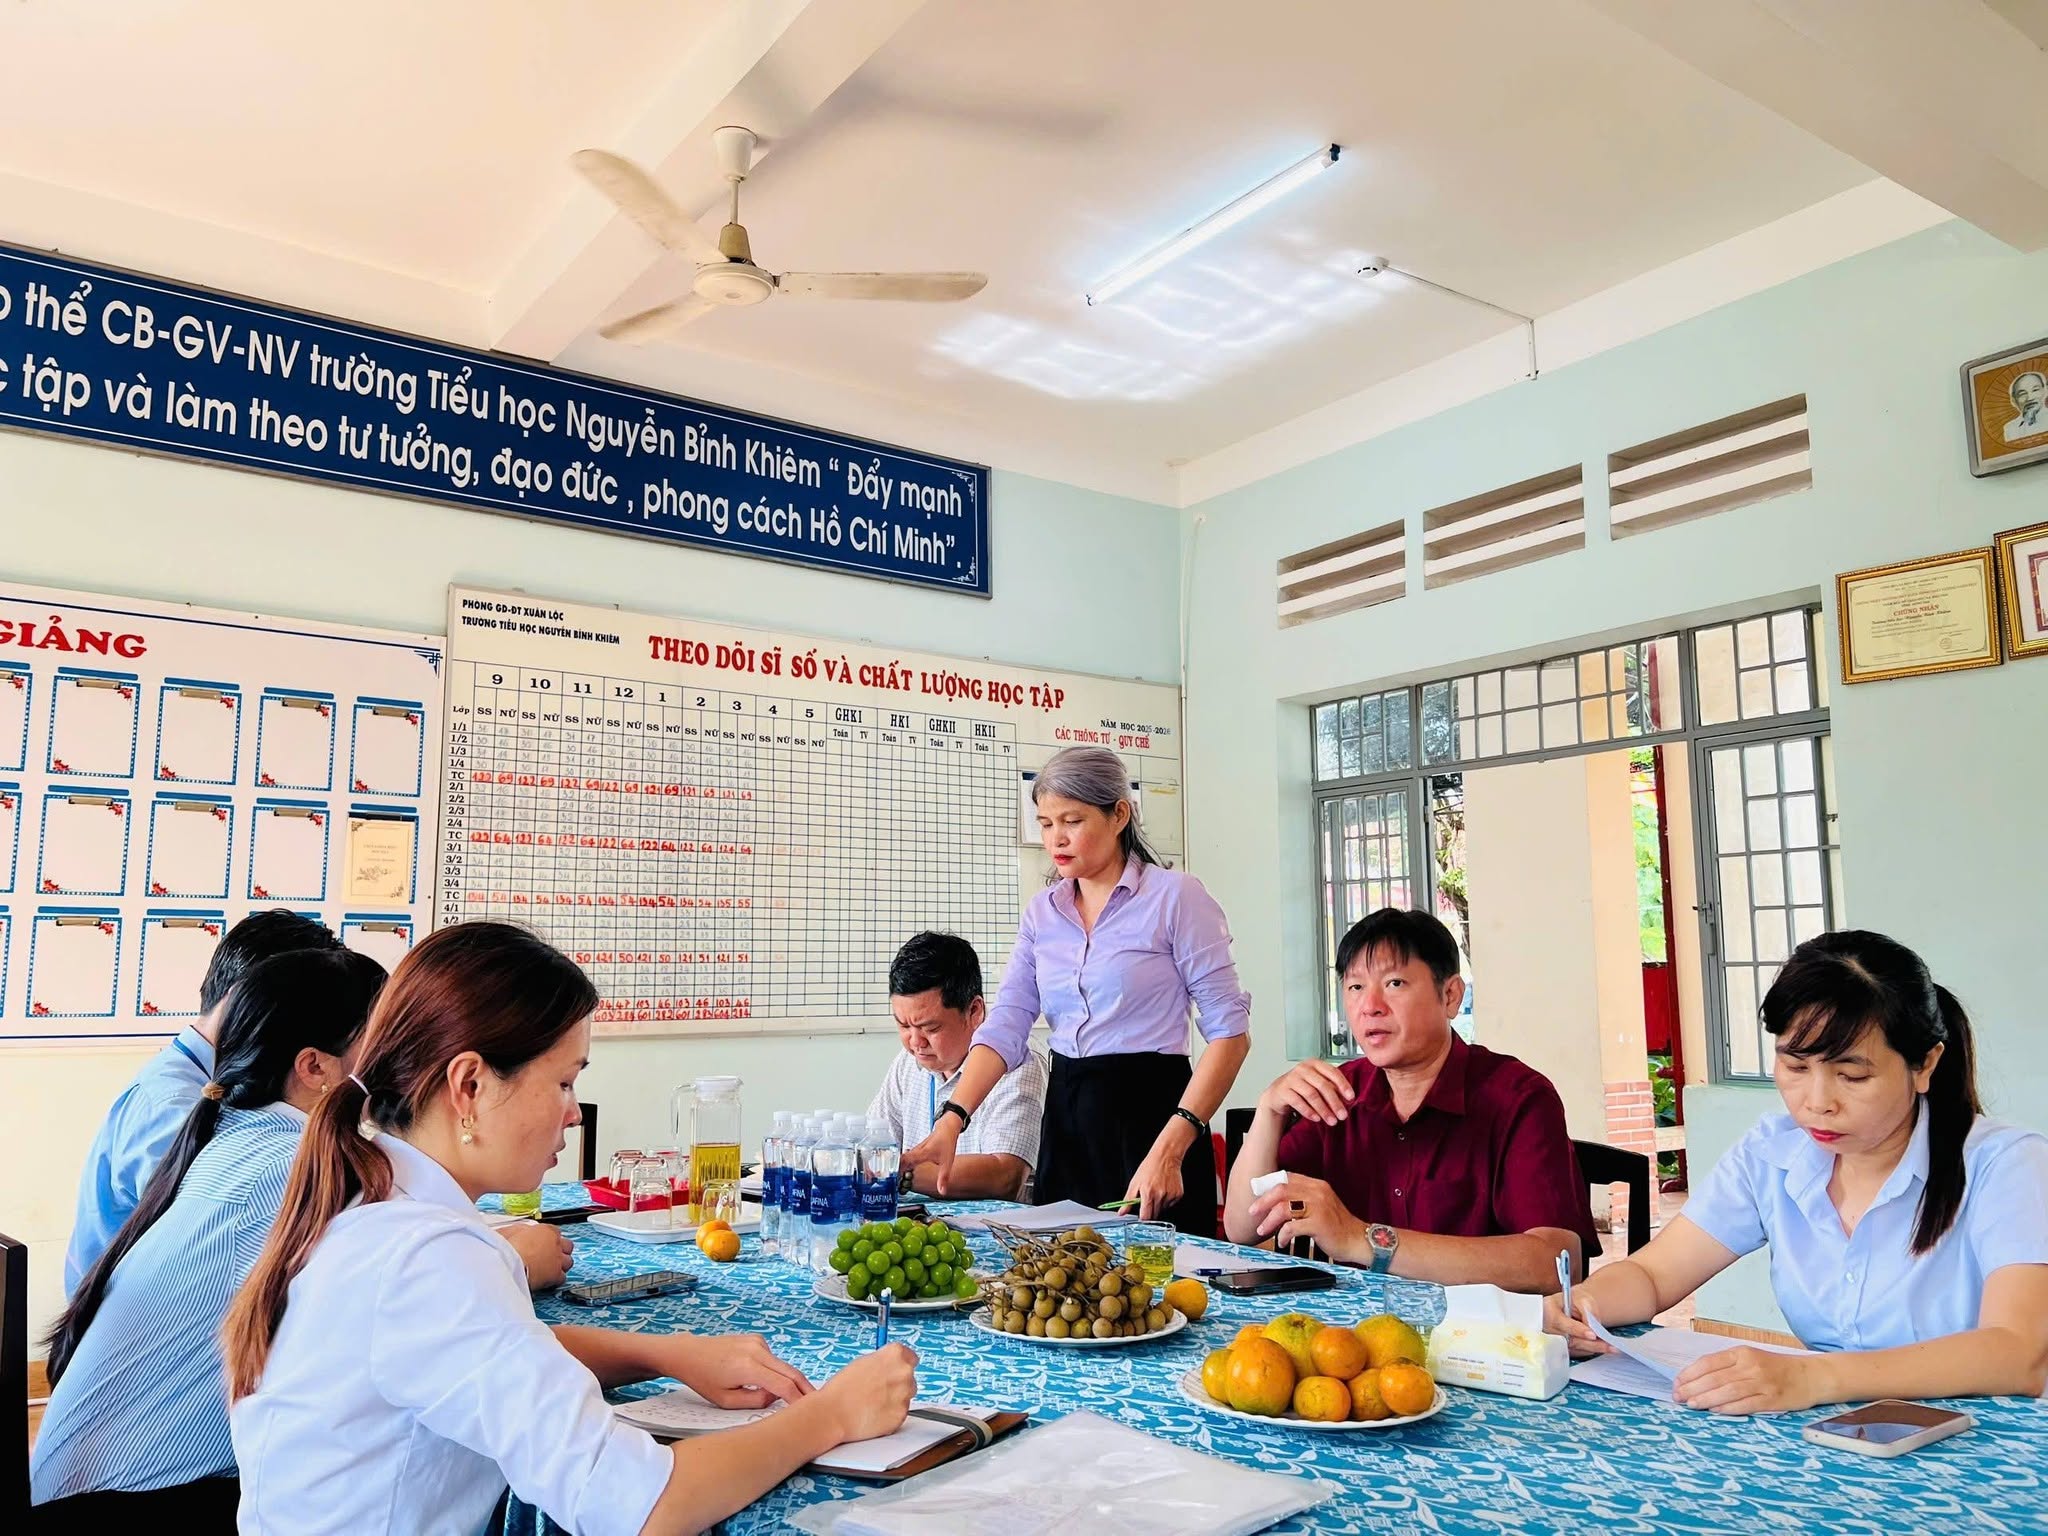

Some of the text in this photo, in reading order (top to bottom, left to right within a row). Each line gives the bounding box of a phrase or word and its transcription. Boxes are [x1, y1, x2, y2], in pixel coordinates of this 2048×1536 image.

[25, 281, 92, 336] thể
[102, 301, 301, 379] CB-GV-NV
[310, 344, 416, 415] trường
[428, 366, 488, 420] Tiểu
[499, 385, 555, 438] học
[567, 400, 674, 458] Nguyễn
[685, 423, 737, 471] Bỉnh
[746, 439, 820, 488] Khiêm
[848, 458, 893, 510] Đẩy
[901, 482, 962, 520] mạnh
[23, 354, 90, 416] tập
[105, 373, 152, 420] và
[167, 382, 236, 435] làm
[250, 398, 328, 452] theo
[339, 416, 373, 460] tư
[380, 423, 479, 488] tưởng,
[491, 448, 553, 498] đạo
[562, 462, 618, 505] đức
[644, 479, 729, 535] phong
[738, 496, 802, 539] cách
[811, 505, 841, 547] Hồ
[850, 517, 887, 555] Chí
[648, 635, 1065, 713] THEO DÕI SĨ SỐ VÀ CHẤT LƯỢNG HỌC TẬP
[492, 674, 996, 738] 9 10 11 12 1 2 3 4 5 GHKI HKI GHKII HKII
[452, 722, 467, 731] 1/1
[453, 705, 470, 715] Lớp
[477, 707, 492, 715] SS
[522, 711, 536, 720] SS
[565, 716, 579, 724] SS
[606, 719, 621, 728] SS
[646, 723, 660, 732] SS
[684, 727, 698, 735] SS
[722, 731, 735, 739] SS
[759, 735, 771, 743] SS
[794, 738, 806, 746] SS
[860, 731, 869, 739] TV
[909, 736, 917, 744] TV
[955, 741, 964, 749] TV
[1003, 745, 1011, 753] TV
[1120, 722, 1136, 733] HỌC
[451, 734, 467, 743] 1/2
[450, 746, 467, 755] 1/3
[450, 758, 465, 767] 1/4
[451, 771, 465, 779] TC
[449, 782, 464, 791] 2/1
[448, 794, 465, 803] 2/2
[448, 806, 465, 815] 2/3
[447, 818, 463, 827] 2/4
[448, 831, 462, 839] TC
[446, 843, 462, 852] 3/1
[445, 855, 462, 864] 3/2
[444, 867, 461, 876] 3/3
[444, 879, 460, 888] 3/4
[444, 891, 460, 900] TC
[443, 903, 459, 912] 4/1
[443, 915, 459, 924] 4/2
[861, 1193, 893, 1204] AQUAFINA
